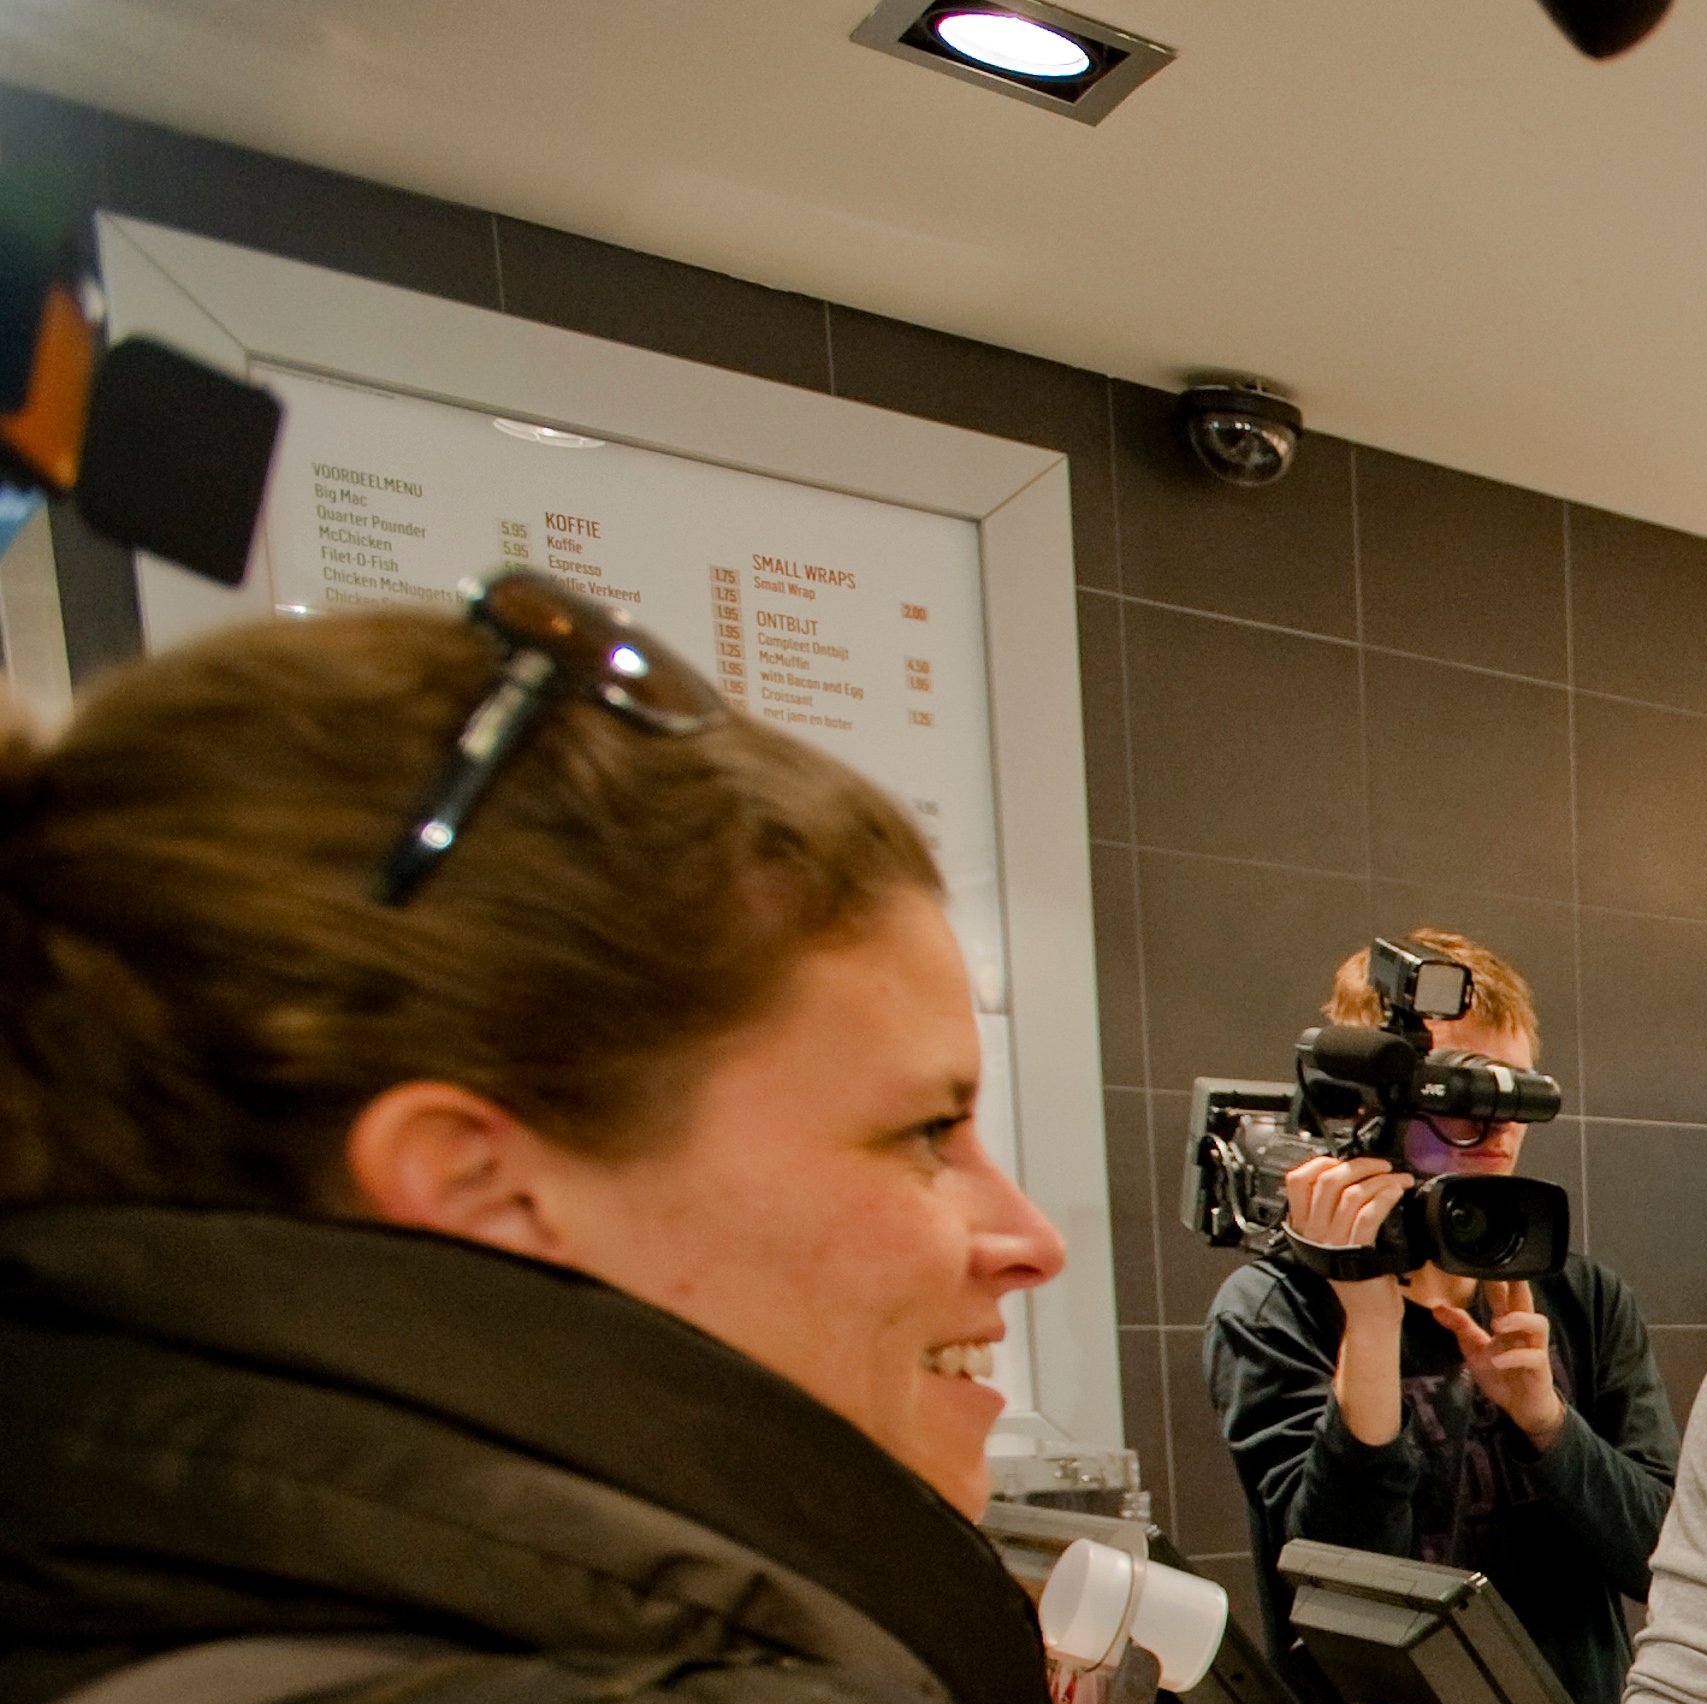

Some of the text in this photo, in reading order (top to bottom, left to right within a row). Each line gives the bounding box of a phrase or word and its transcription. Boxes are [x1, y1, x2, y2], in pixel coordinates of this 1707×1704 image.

[312, 462, 423, 498] VOORDEELMENU
[314, 483, 368, 507] Big Mac
[317, 504, 426, 538] Quarter Pounder
[501, 521, 528, 538] 5.95
[545, 512, 601, 539] KOFFIE
[319, 526, 392, 551] McChicken
[503, 541, 529, 558] 5.95
[547, 535, 583, 554] Koffie
[321, 545, 399, 572] Filet-O-Fish
[549, 555, 602, 576] Espresso
[323, 566, 377, 588] Chicken
[380, 577, 452, 602] McNuggets
[715, 568, 736, 585] 1.75
[752, 554, 856, 590] SMALL WRAPS
[588, 582, 641, 604] Verkeerd
[716, 587, 738, 603] 1.75
[753, 576, 816, 601] Small Wrap
[756, 610, 818, 636] ONTBIJT
[758, 632, 849, 662] Compleet Ontbijt
[759, 650, 810, 671] McMuffin
[760, 671, 864, 701] with Bacon and Egg
[761, 686, 813, 707] Croissant
